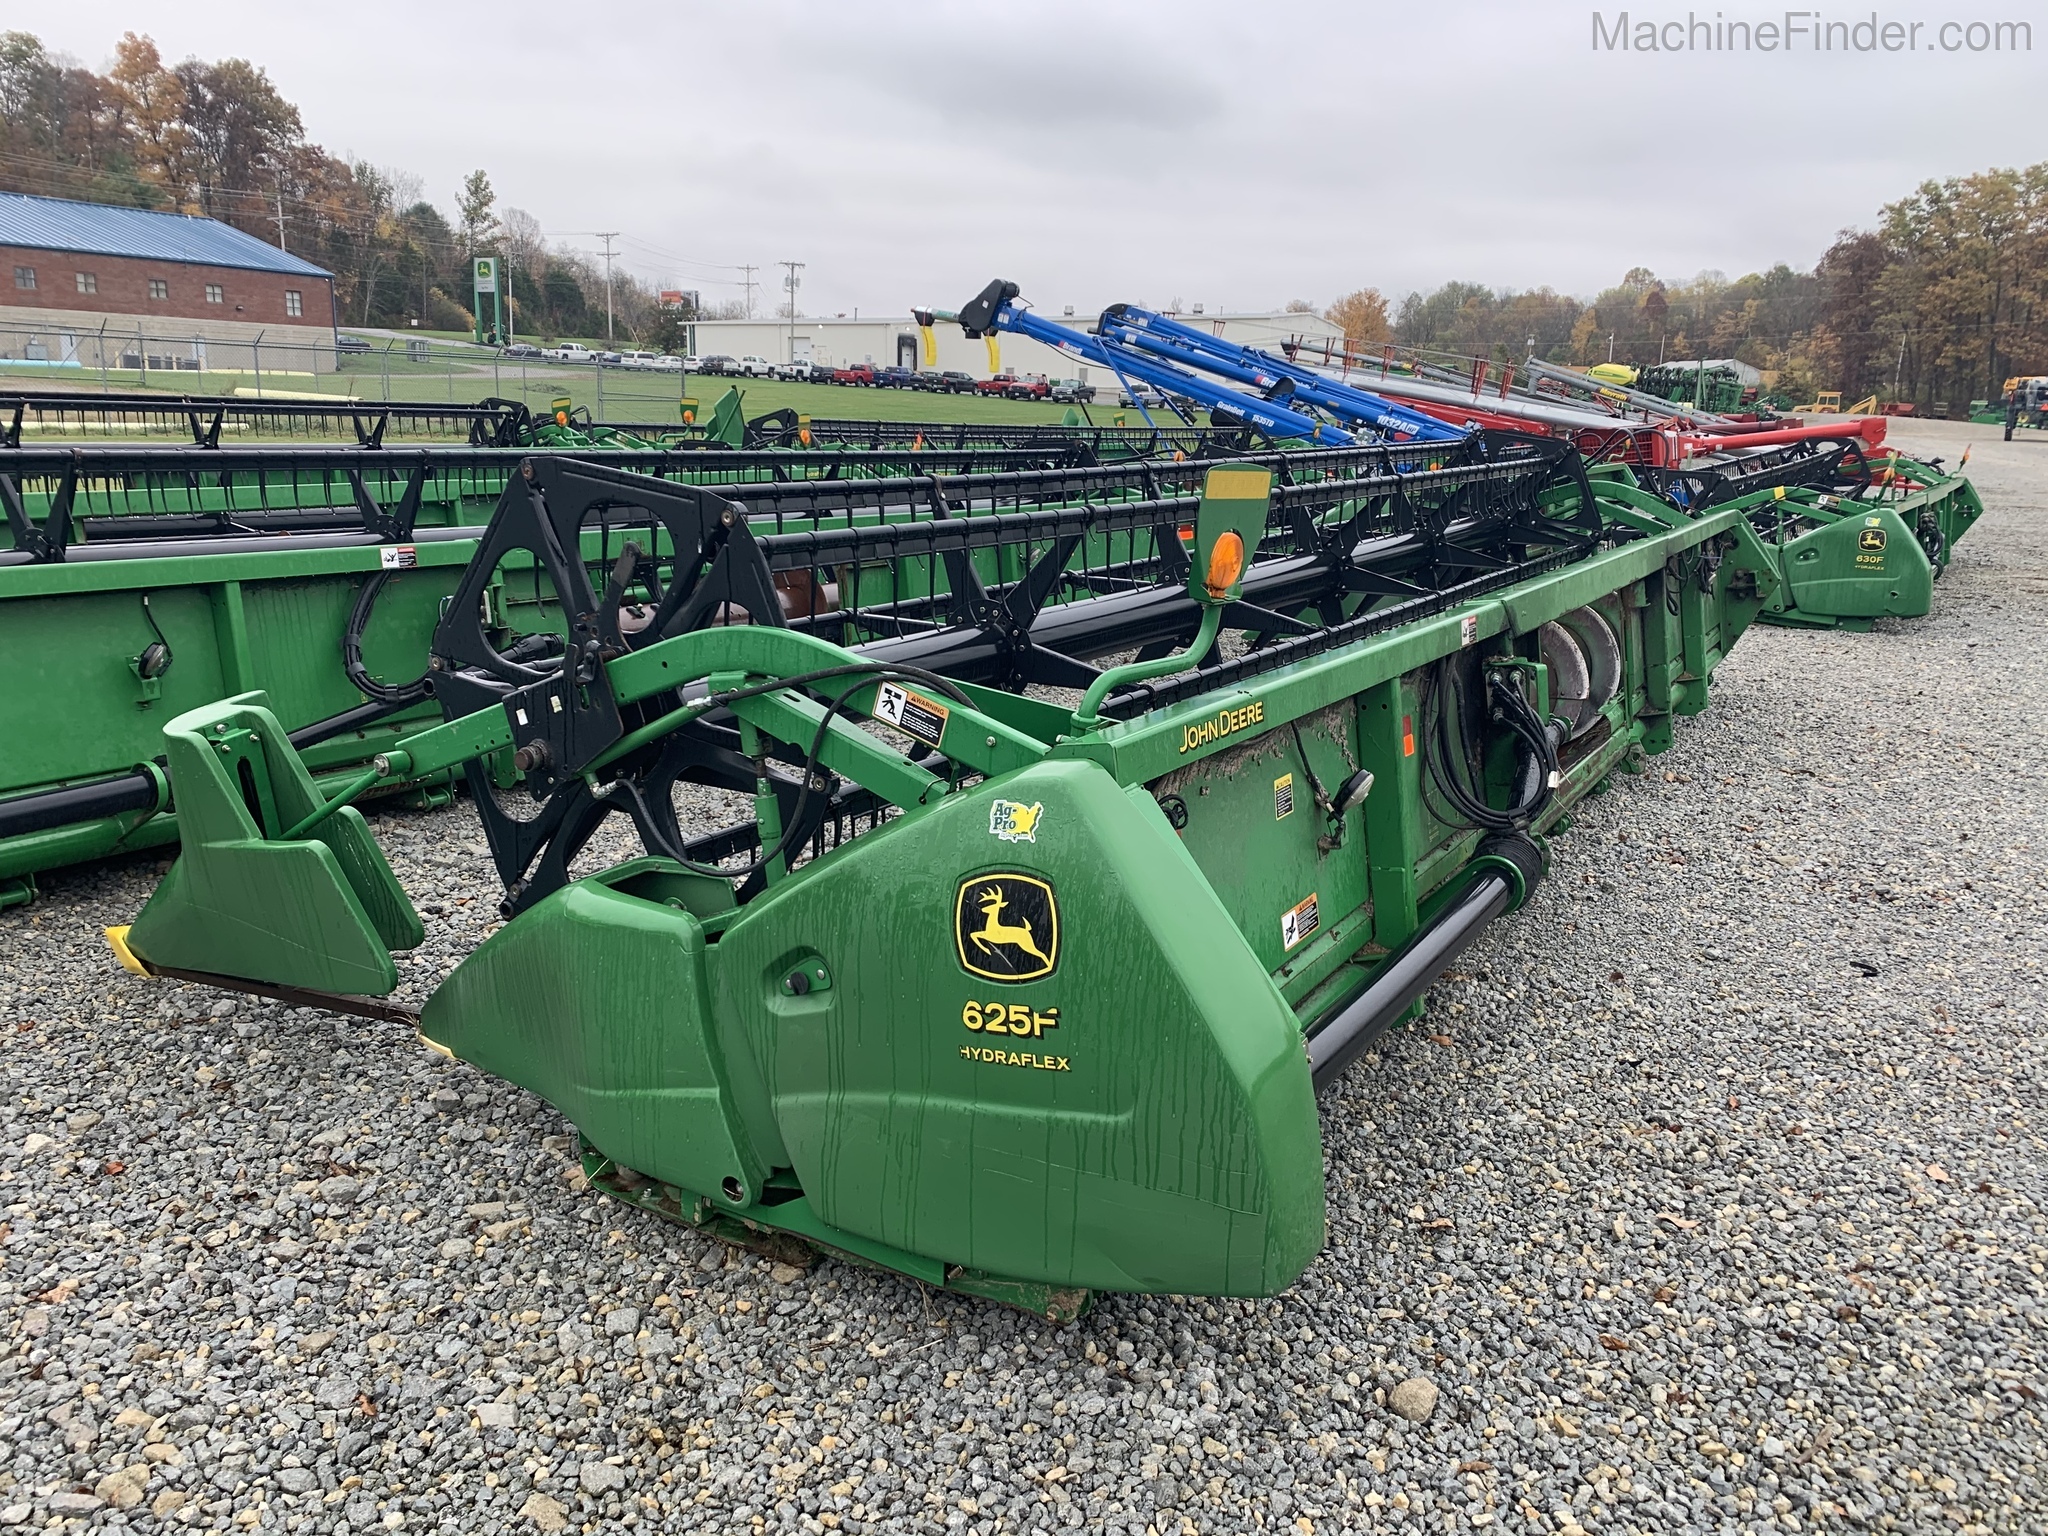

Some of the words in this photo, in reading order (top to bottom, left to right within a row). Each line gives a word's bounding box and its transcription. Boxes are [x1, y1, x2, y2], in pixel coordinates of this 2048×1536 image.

[1062, 341, 1083, 356] Brandt
[1252, 414, 1275, 428] 1535TD
[1855, 554, 1885, 565] 630F
[915, 697, 945, 716] WARNING
[1179, 718, 1219, 755] JOHN
[1219, 701, 1264, 737] DEERE
[962, 999, 1060, 1040] 625F
[959, 1045, 1072, 1072] HYDRAFLEX
